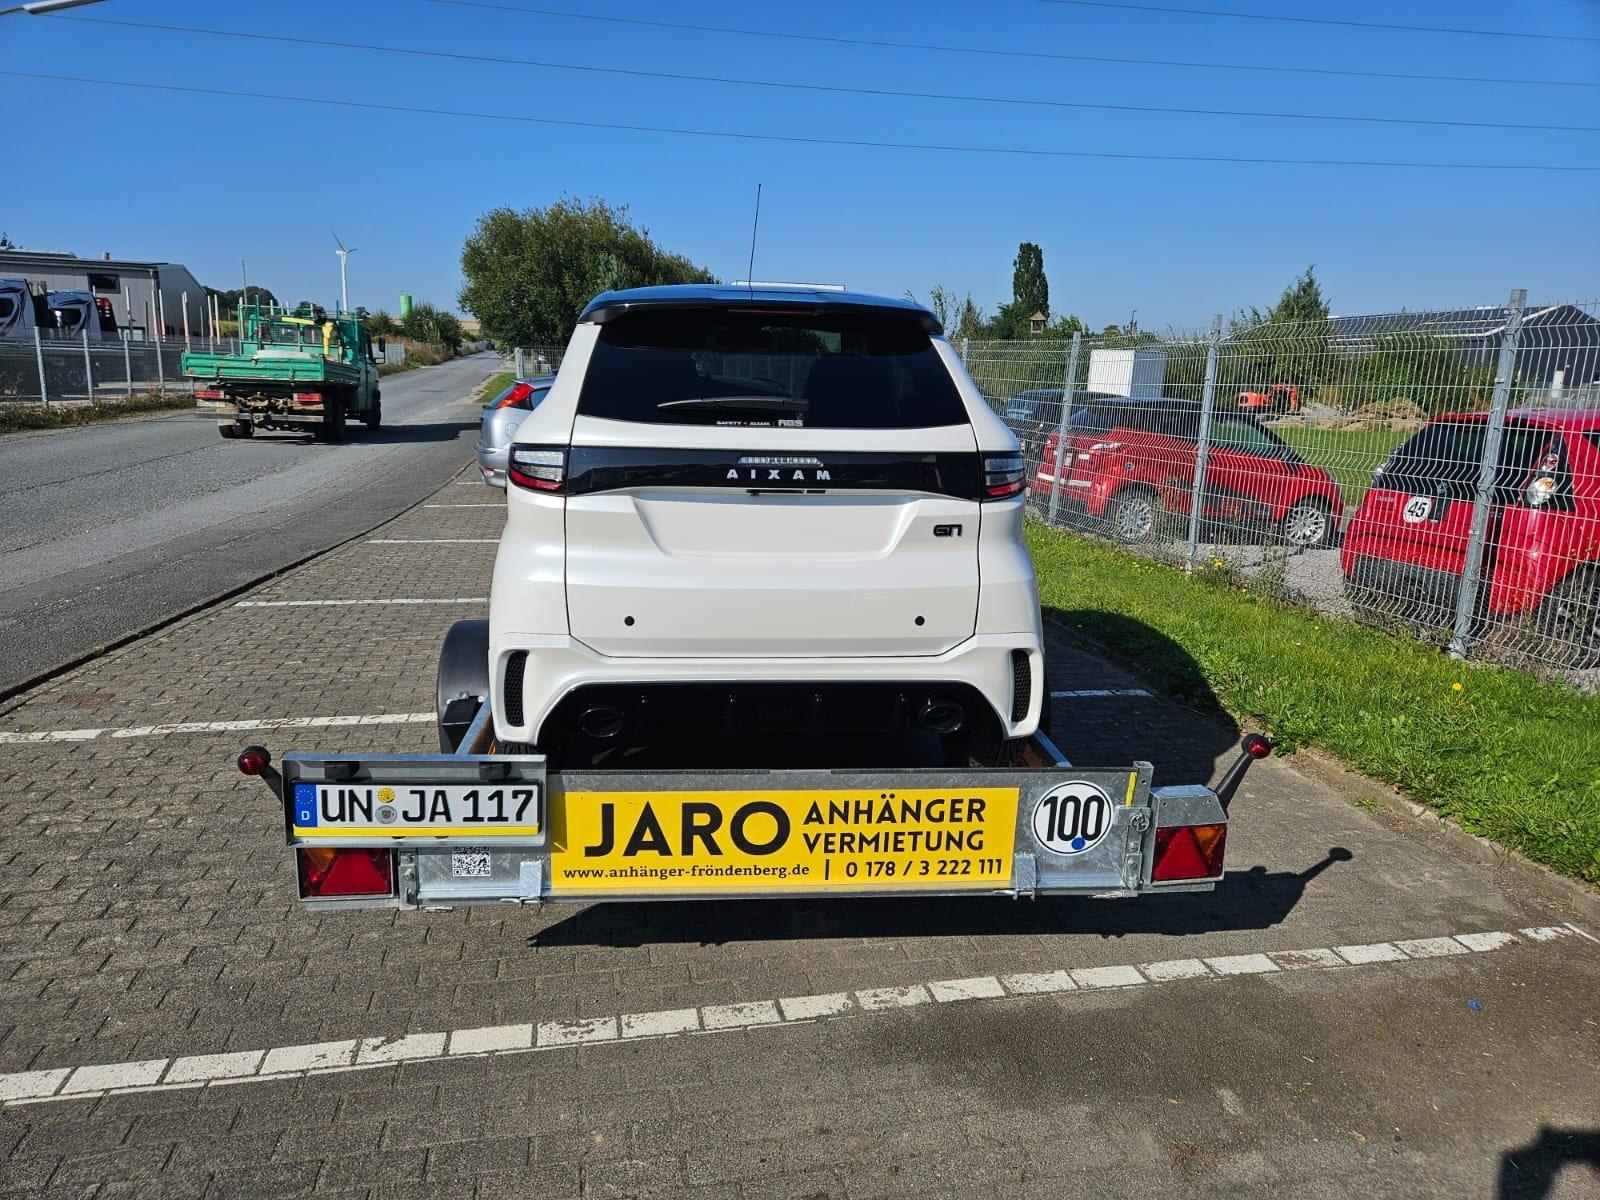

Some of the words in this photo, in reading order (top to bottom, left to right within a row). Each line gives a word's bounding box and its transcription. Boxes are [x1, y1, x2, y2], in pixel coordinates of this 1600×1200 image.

[726, 469, 831, 480] AIXAM
[1407, 501, 1428, 518] 45
[301, 810, 310, 821] D
[321, 789, 373, 822] UN
[402, 789, 452, 822] JA
[462, 789, 533, 822] 117
[803, 793, 986, 825] ANHÄNGER
[584, 801, 791, 857] JARO
[1043, 794, 1105, 842] 100
[802, 830, 984, 854] VERMIETUNG
[563, 864, 810, 880] www.anhänger-fröndenberg.de
[845, 861, 858, 877] 0
[865, 861, 896, 877] 178
[919, 860, 930, 875] 3
[937, 859, 971, 875] 222
[978, 858, 1003, 874] 111
